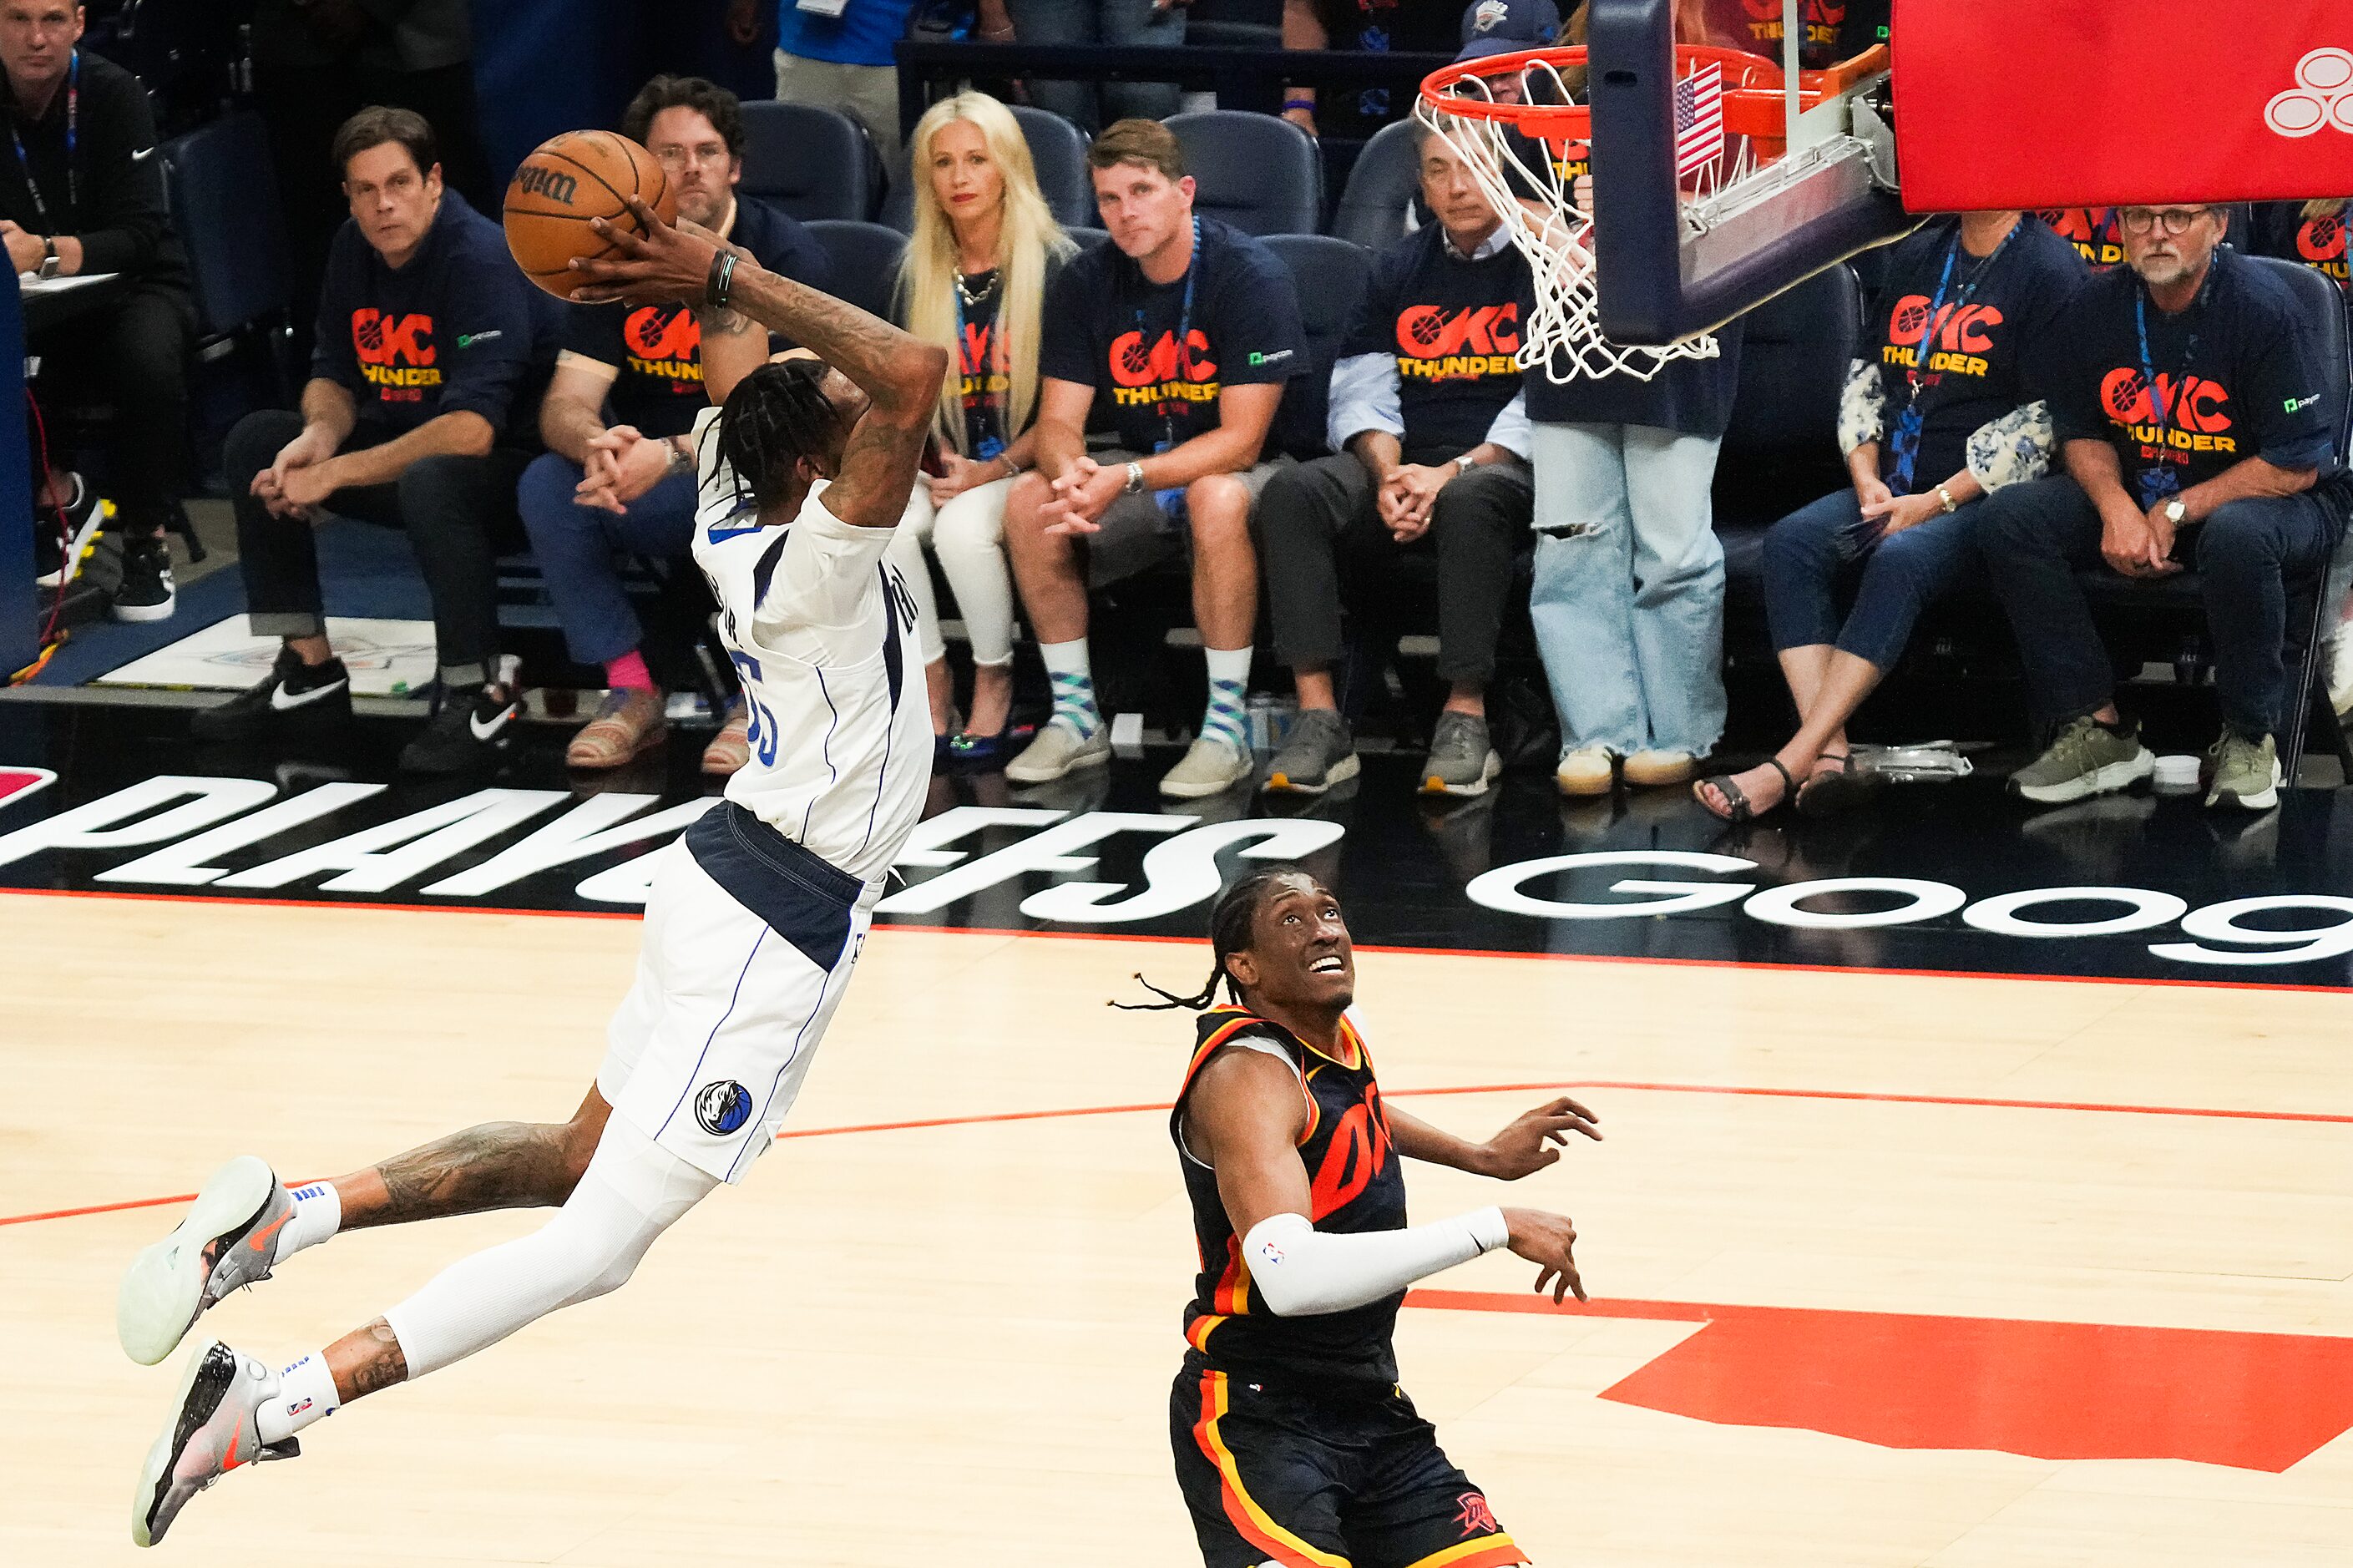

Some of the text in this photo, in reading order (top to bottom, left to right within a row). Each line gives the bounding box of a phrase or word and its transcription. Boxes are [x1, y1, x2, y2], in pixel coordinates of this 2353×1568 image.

[352, 307, 436, 366] OKC
[1396, 301, 1520, 359] OKC
[1890, 295, 2003, 352] OKC
[1109, 329, 1217, 387] OKC
[2100, 367, 2232, 432] OKC
